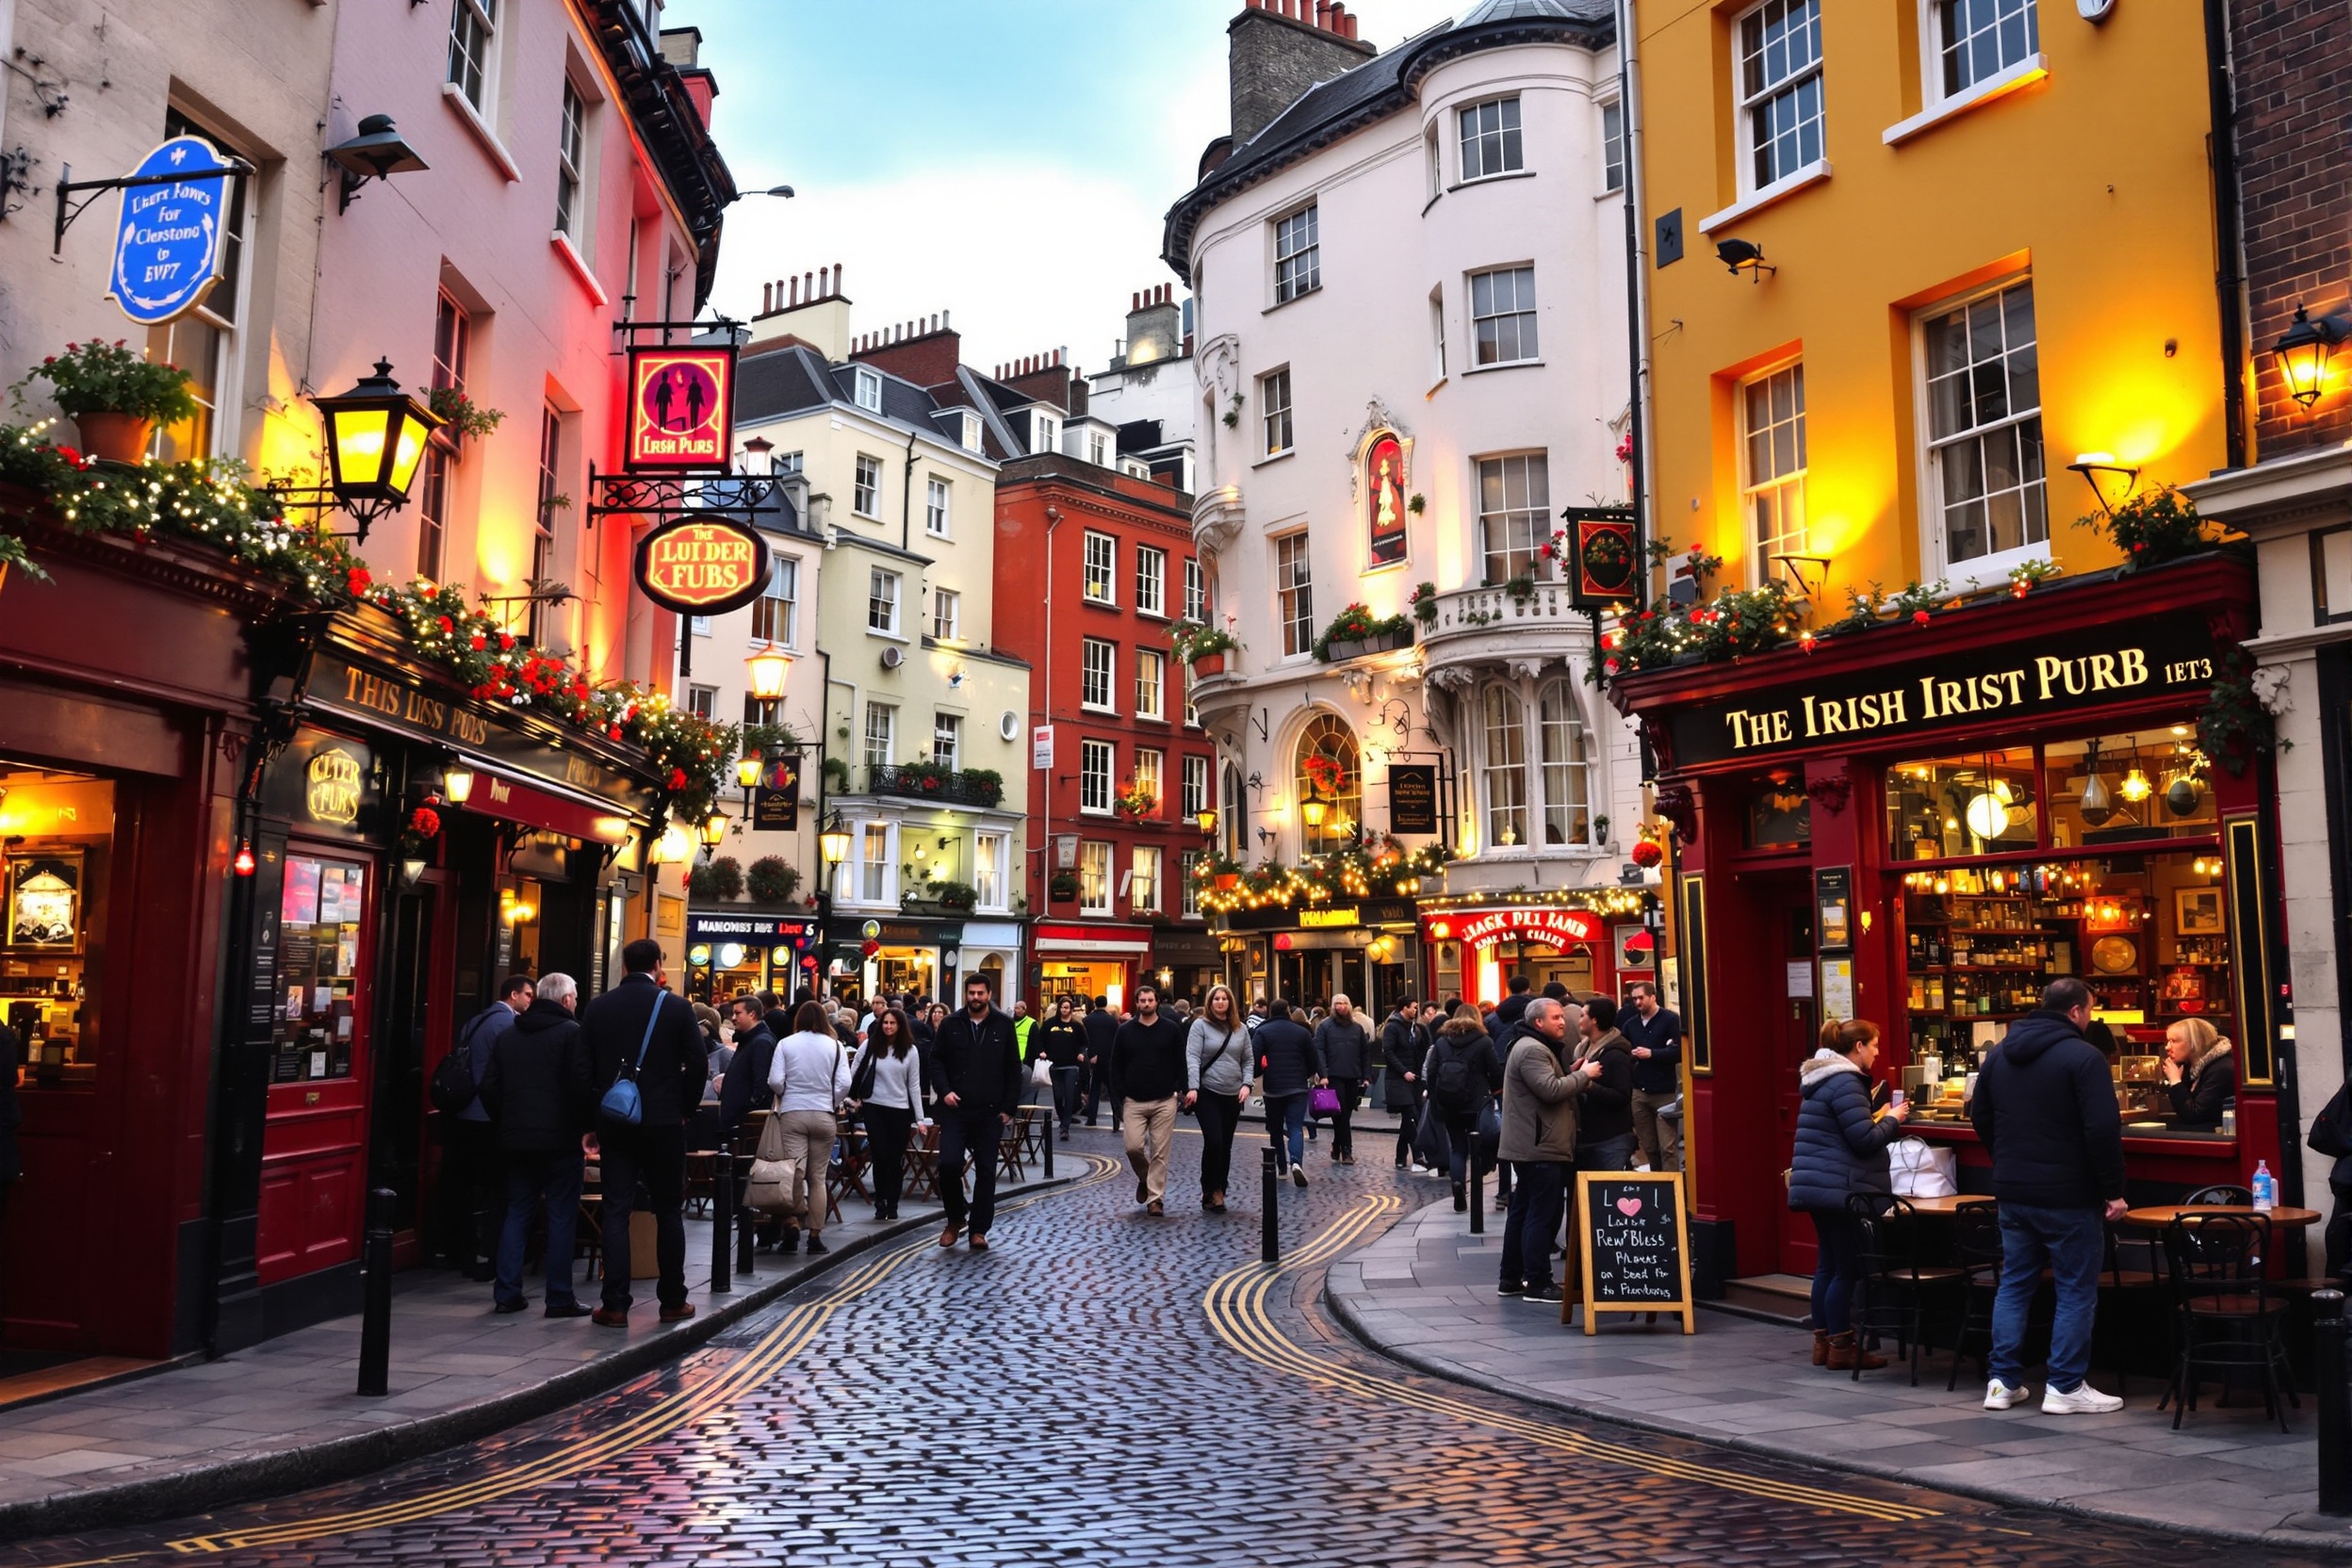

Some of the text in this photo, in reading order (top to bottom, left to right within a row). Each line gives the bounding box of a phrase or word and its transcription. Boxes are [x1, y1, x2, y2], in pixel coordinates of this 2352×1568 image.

[1726, 710, 1792, 749] THE
[1802, 695, 1908, 737] IRISH
[1919, 676, 2025, 719] IRIST
[2034, 648, 2148, 700] PURB
